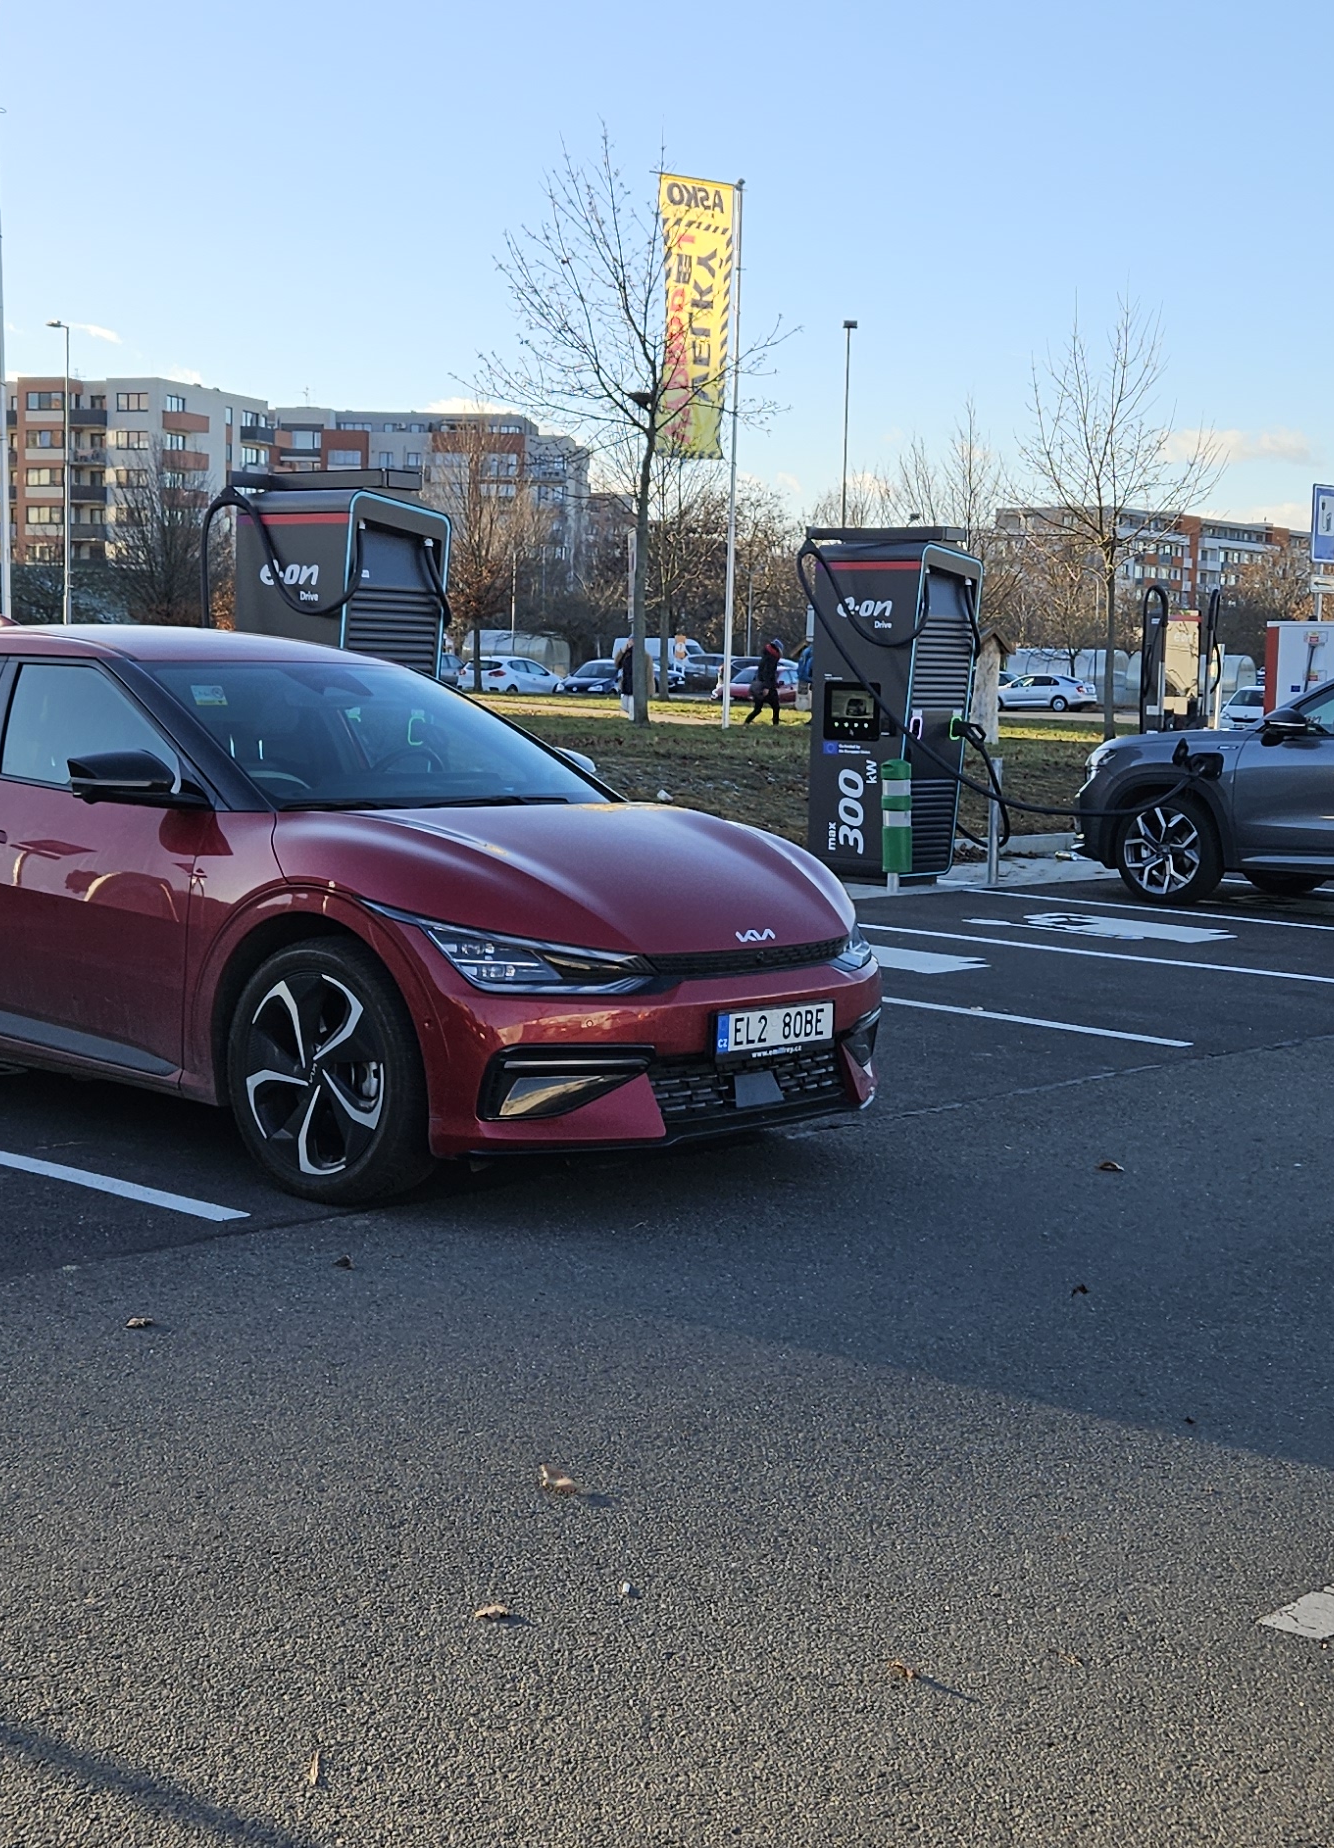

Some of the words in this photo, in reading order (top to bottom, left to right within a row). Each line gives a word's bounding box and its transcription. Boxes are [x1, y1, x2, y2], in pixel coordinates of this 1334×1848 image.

[300, 590, 319, 601] Drive
[874, 620, 892, 629] Drive
[866, 760, 877, 784] kW
[838, 769, 864, 854] 300
[828, 822, 836, 850] max
[735, 929, 776, 943] KIA
[718, 1038, 728, 1049] CZ
[734, 1014, 768, 1046] EL2
[782, 1007, 825, 1041] 80BE
